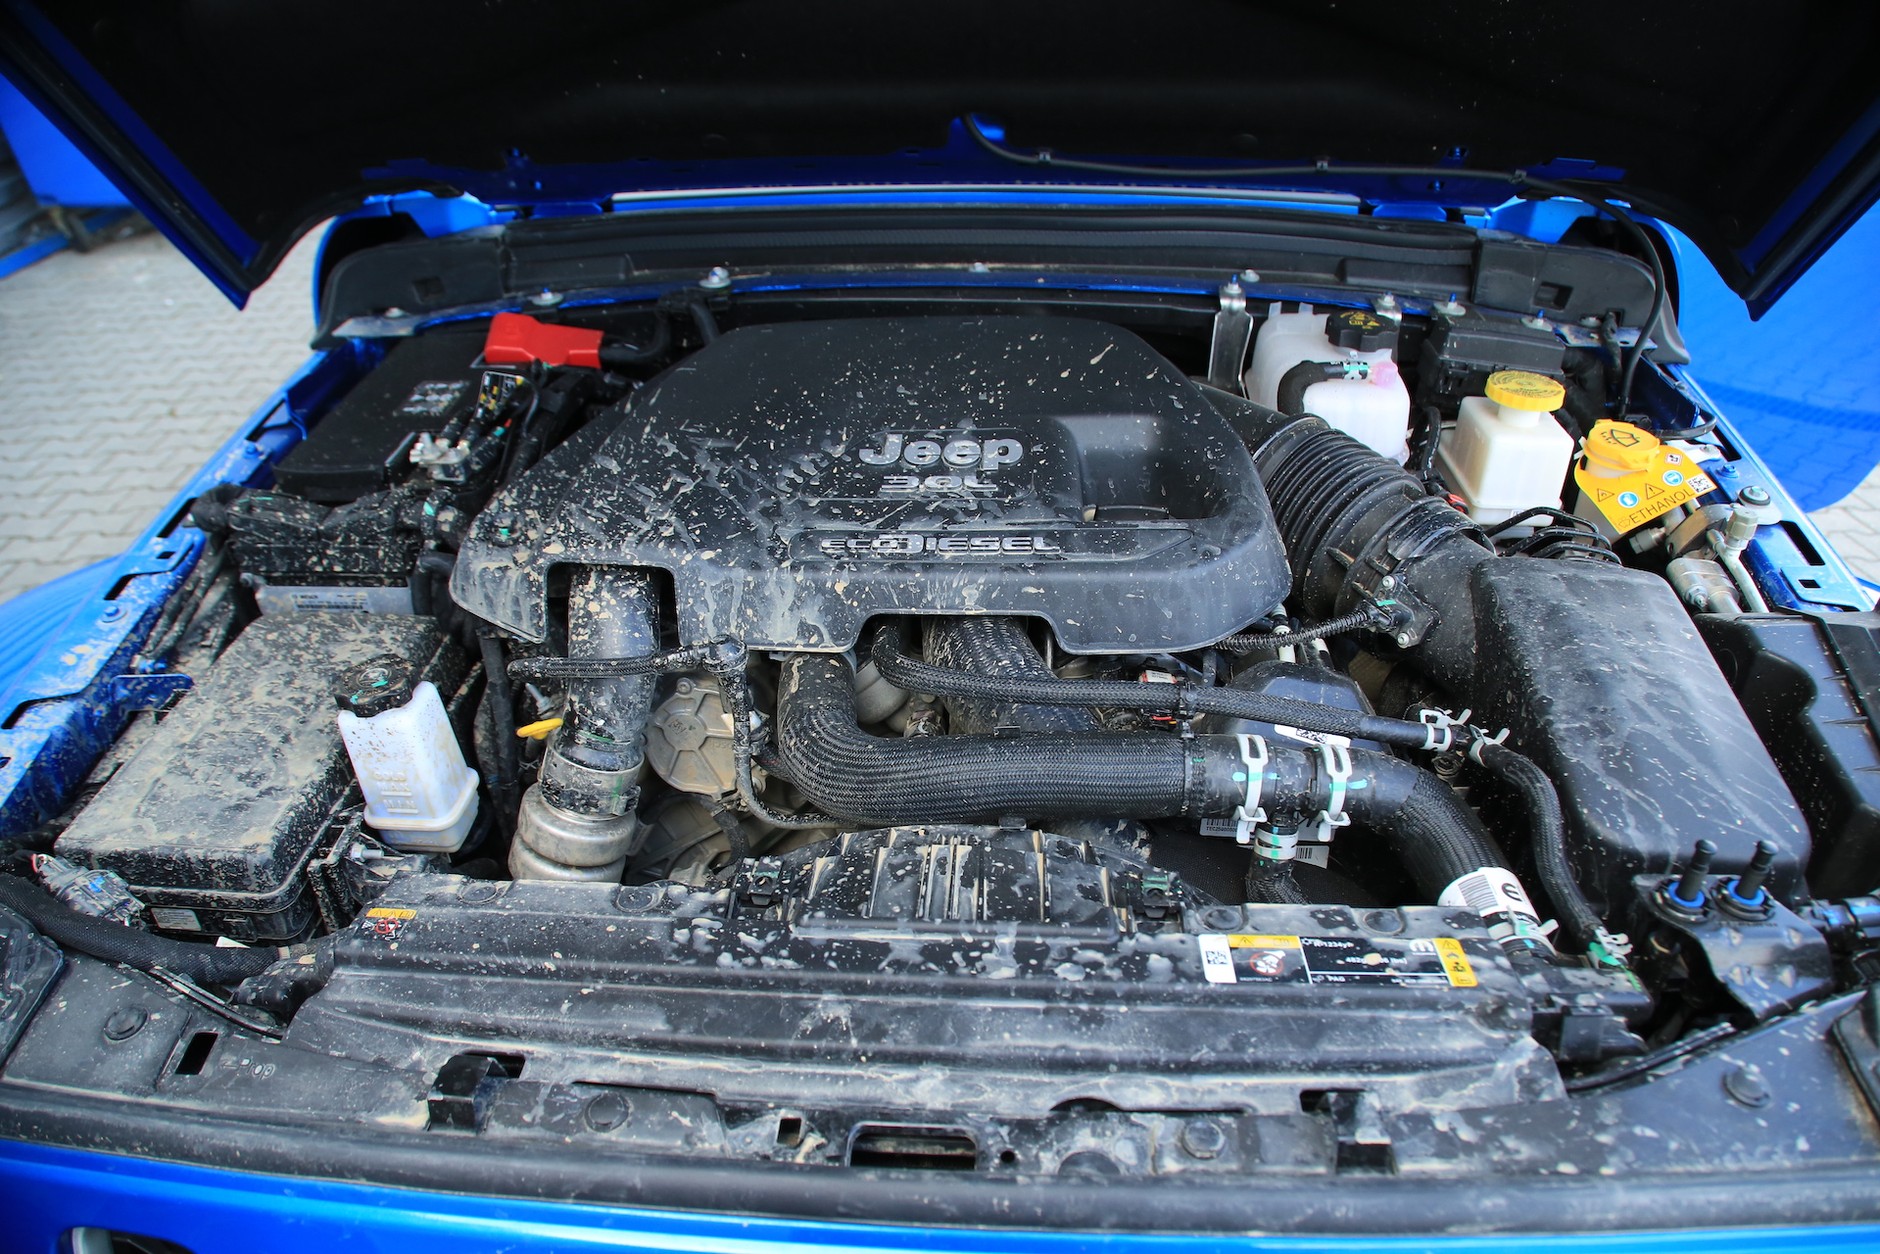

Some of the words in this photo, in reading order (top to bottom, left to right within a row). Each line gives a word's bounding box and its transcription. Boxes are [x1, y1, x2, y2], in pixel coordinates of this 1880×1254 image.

[858, 433, 1023, 471] Jeep
[1628, 488, 1696, 524] ETHANOL
[240, 1057, 276, 1080] Prop
